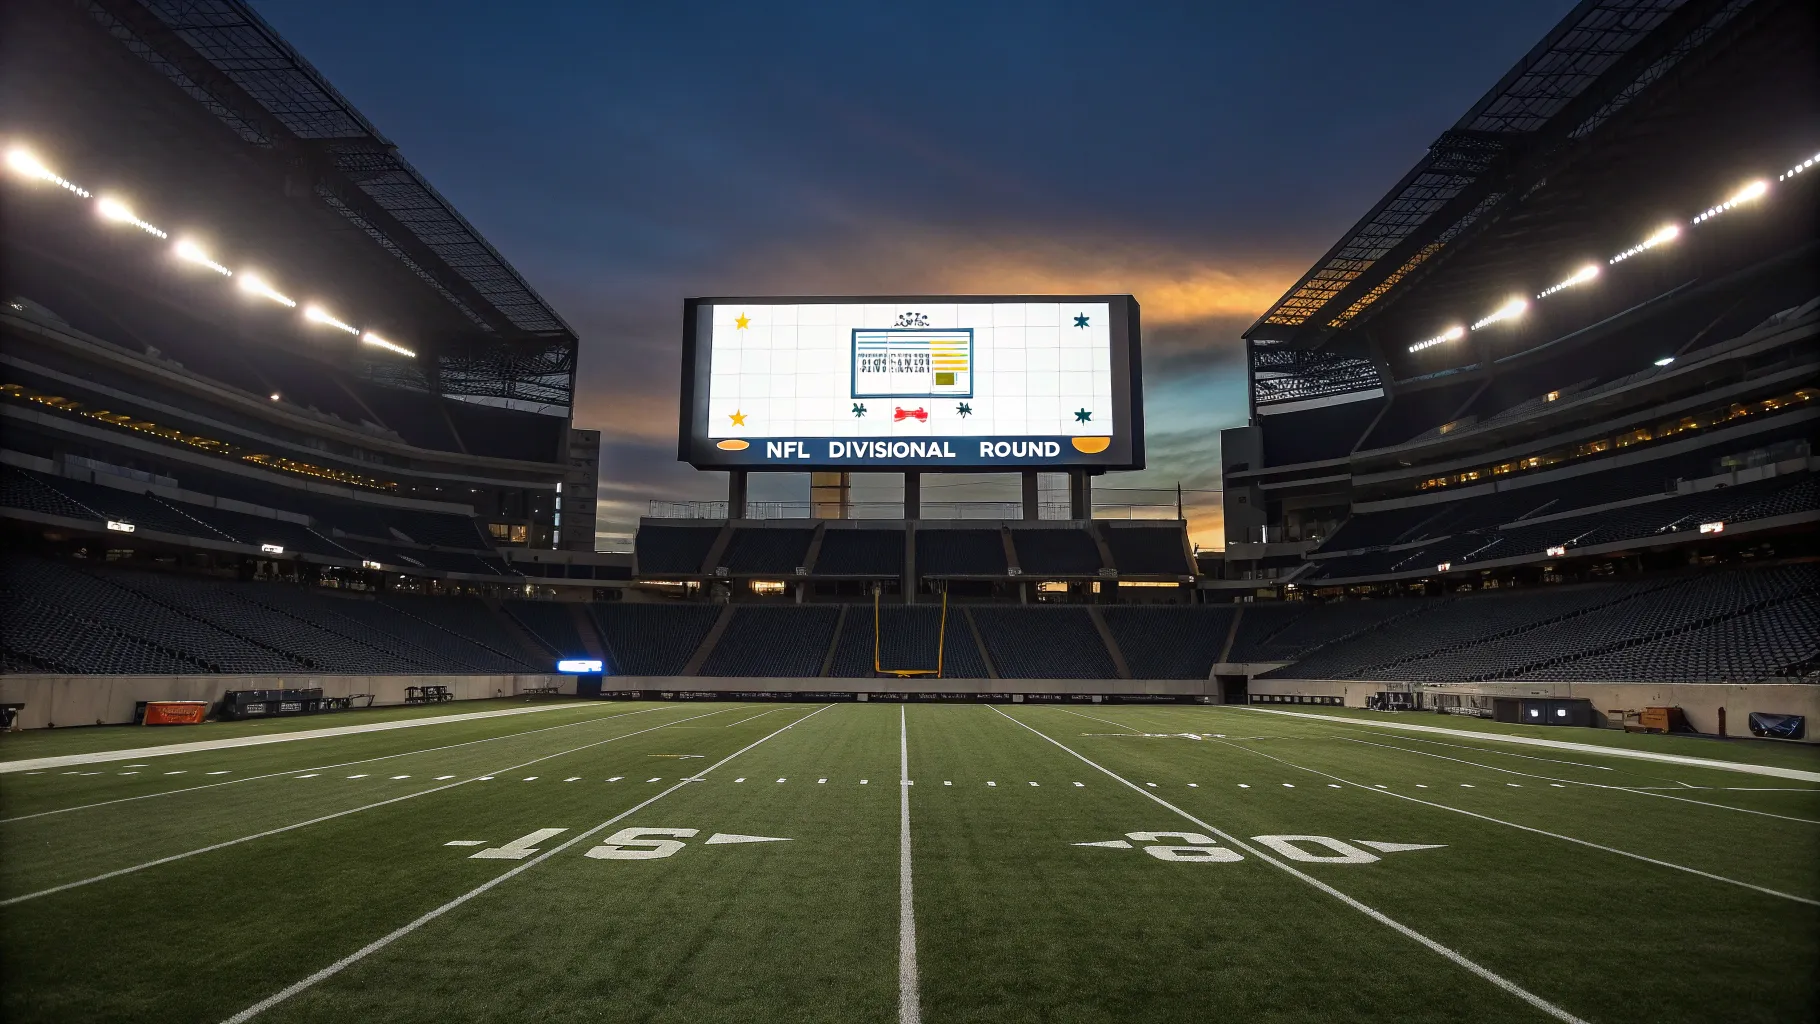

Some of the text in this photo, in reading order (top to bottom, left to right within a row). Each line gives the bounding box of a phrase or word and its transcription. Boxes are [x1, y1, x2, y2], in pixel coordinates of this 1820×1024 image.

[767, 441, 1061, 458] NFL DIVISIONAL ROUND
